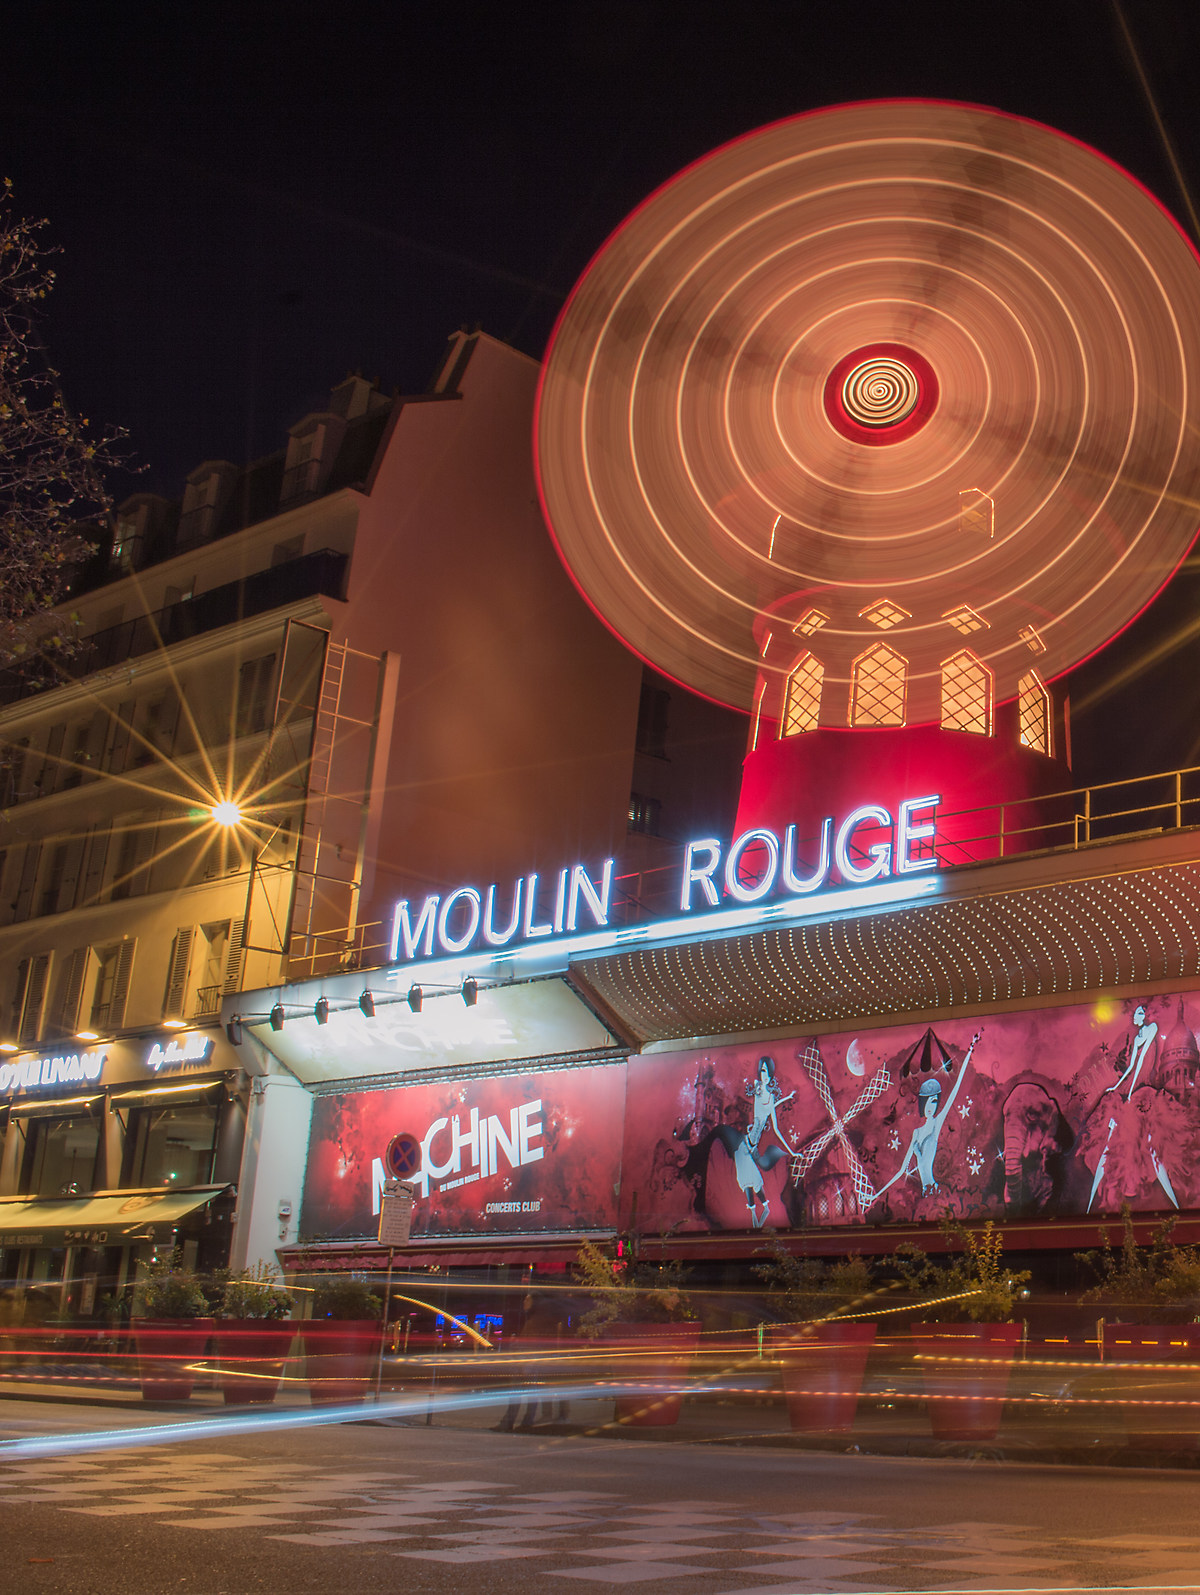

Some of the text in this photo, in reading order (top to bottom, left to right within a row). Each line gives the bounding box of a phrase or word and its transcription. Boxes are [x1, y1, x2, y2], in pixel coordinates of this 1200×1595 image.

[389, 793, 942, 961] MOULIN ROUGE
[485, 1200, 541, 1214] CONCERTS CLUB
